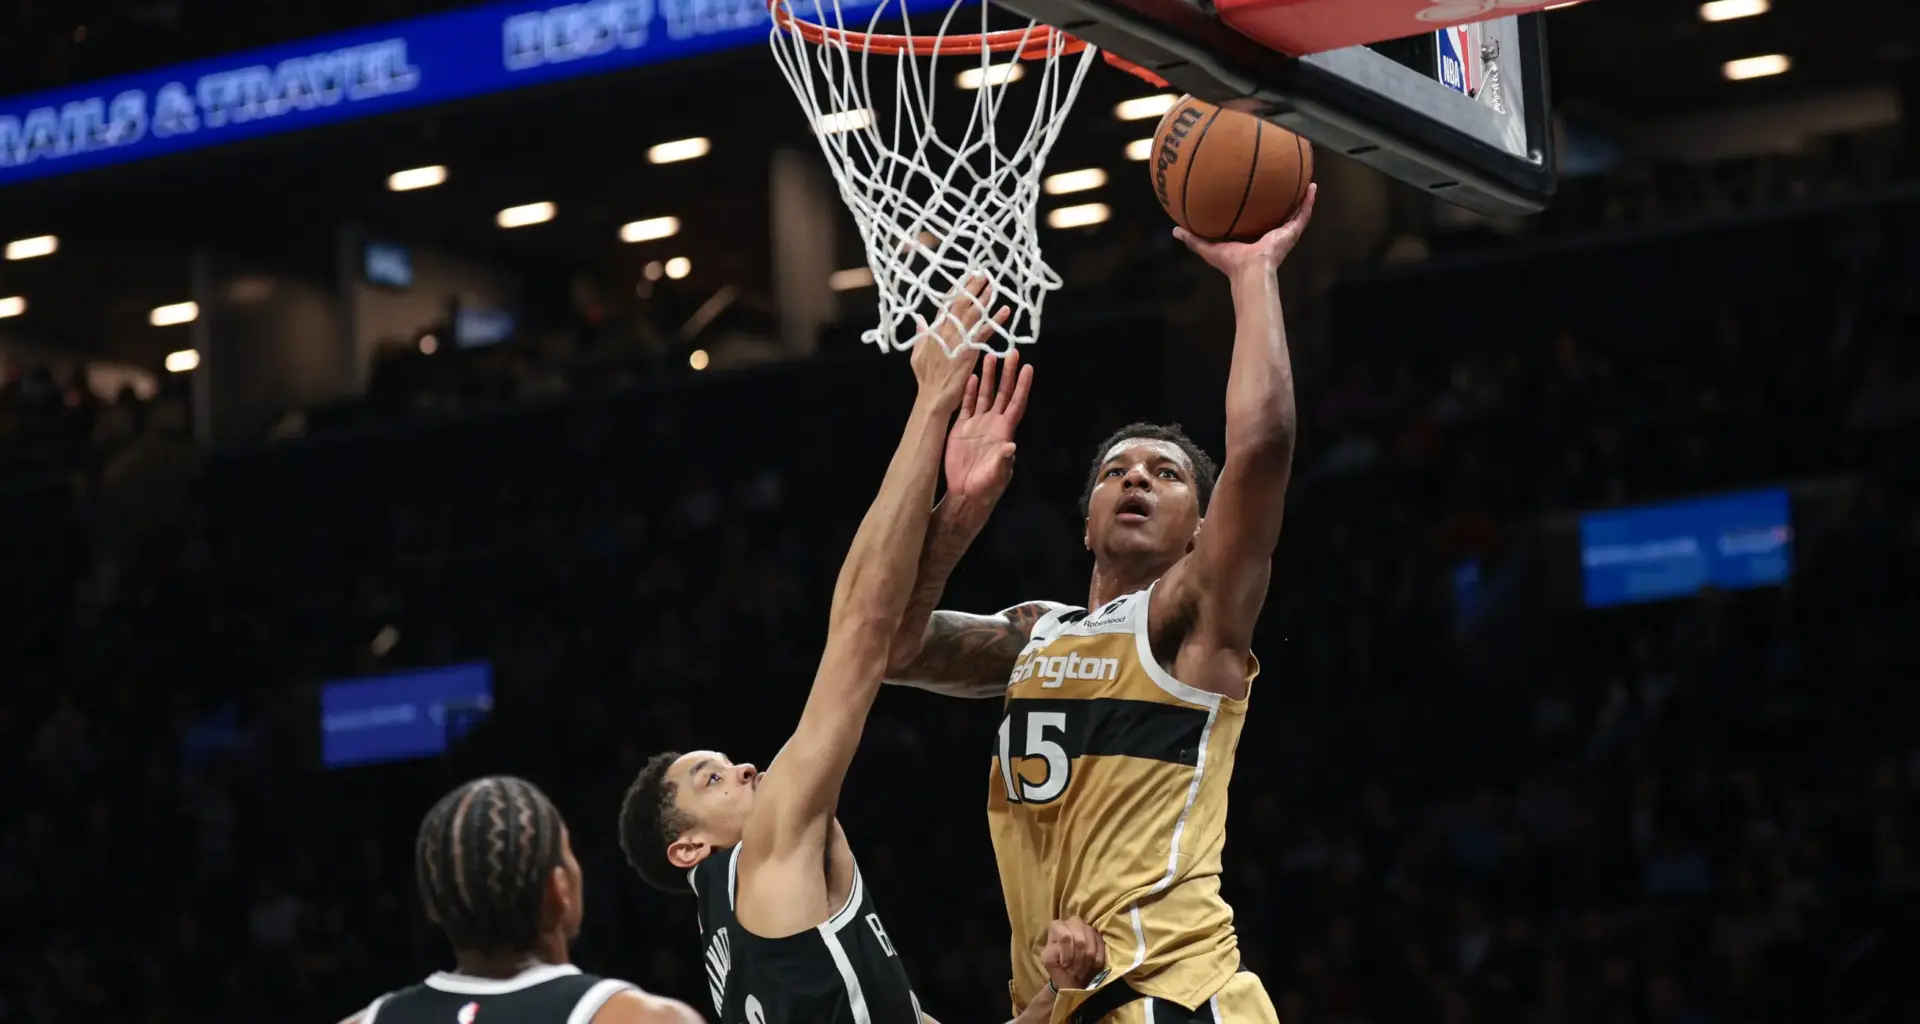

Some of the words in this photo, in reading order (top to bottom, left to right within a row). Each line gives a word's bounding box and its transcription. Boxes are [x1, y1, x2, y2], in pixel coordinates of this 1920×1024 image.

[1442, 54, 1461, 89] NBA
[1157, 107, 1203, 206] Wilson
[1083, 615, 1127, 628] Robinhood
[998, 711, 1072, 804] 15
